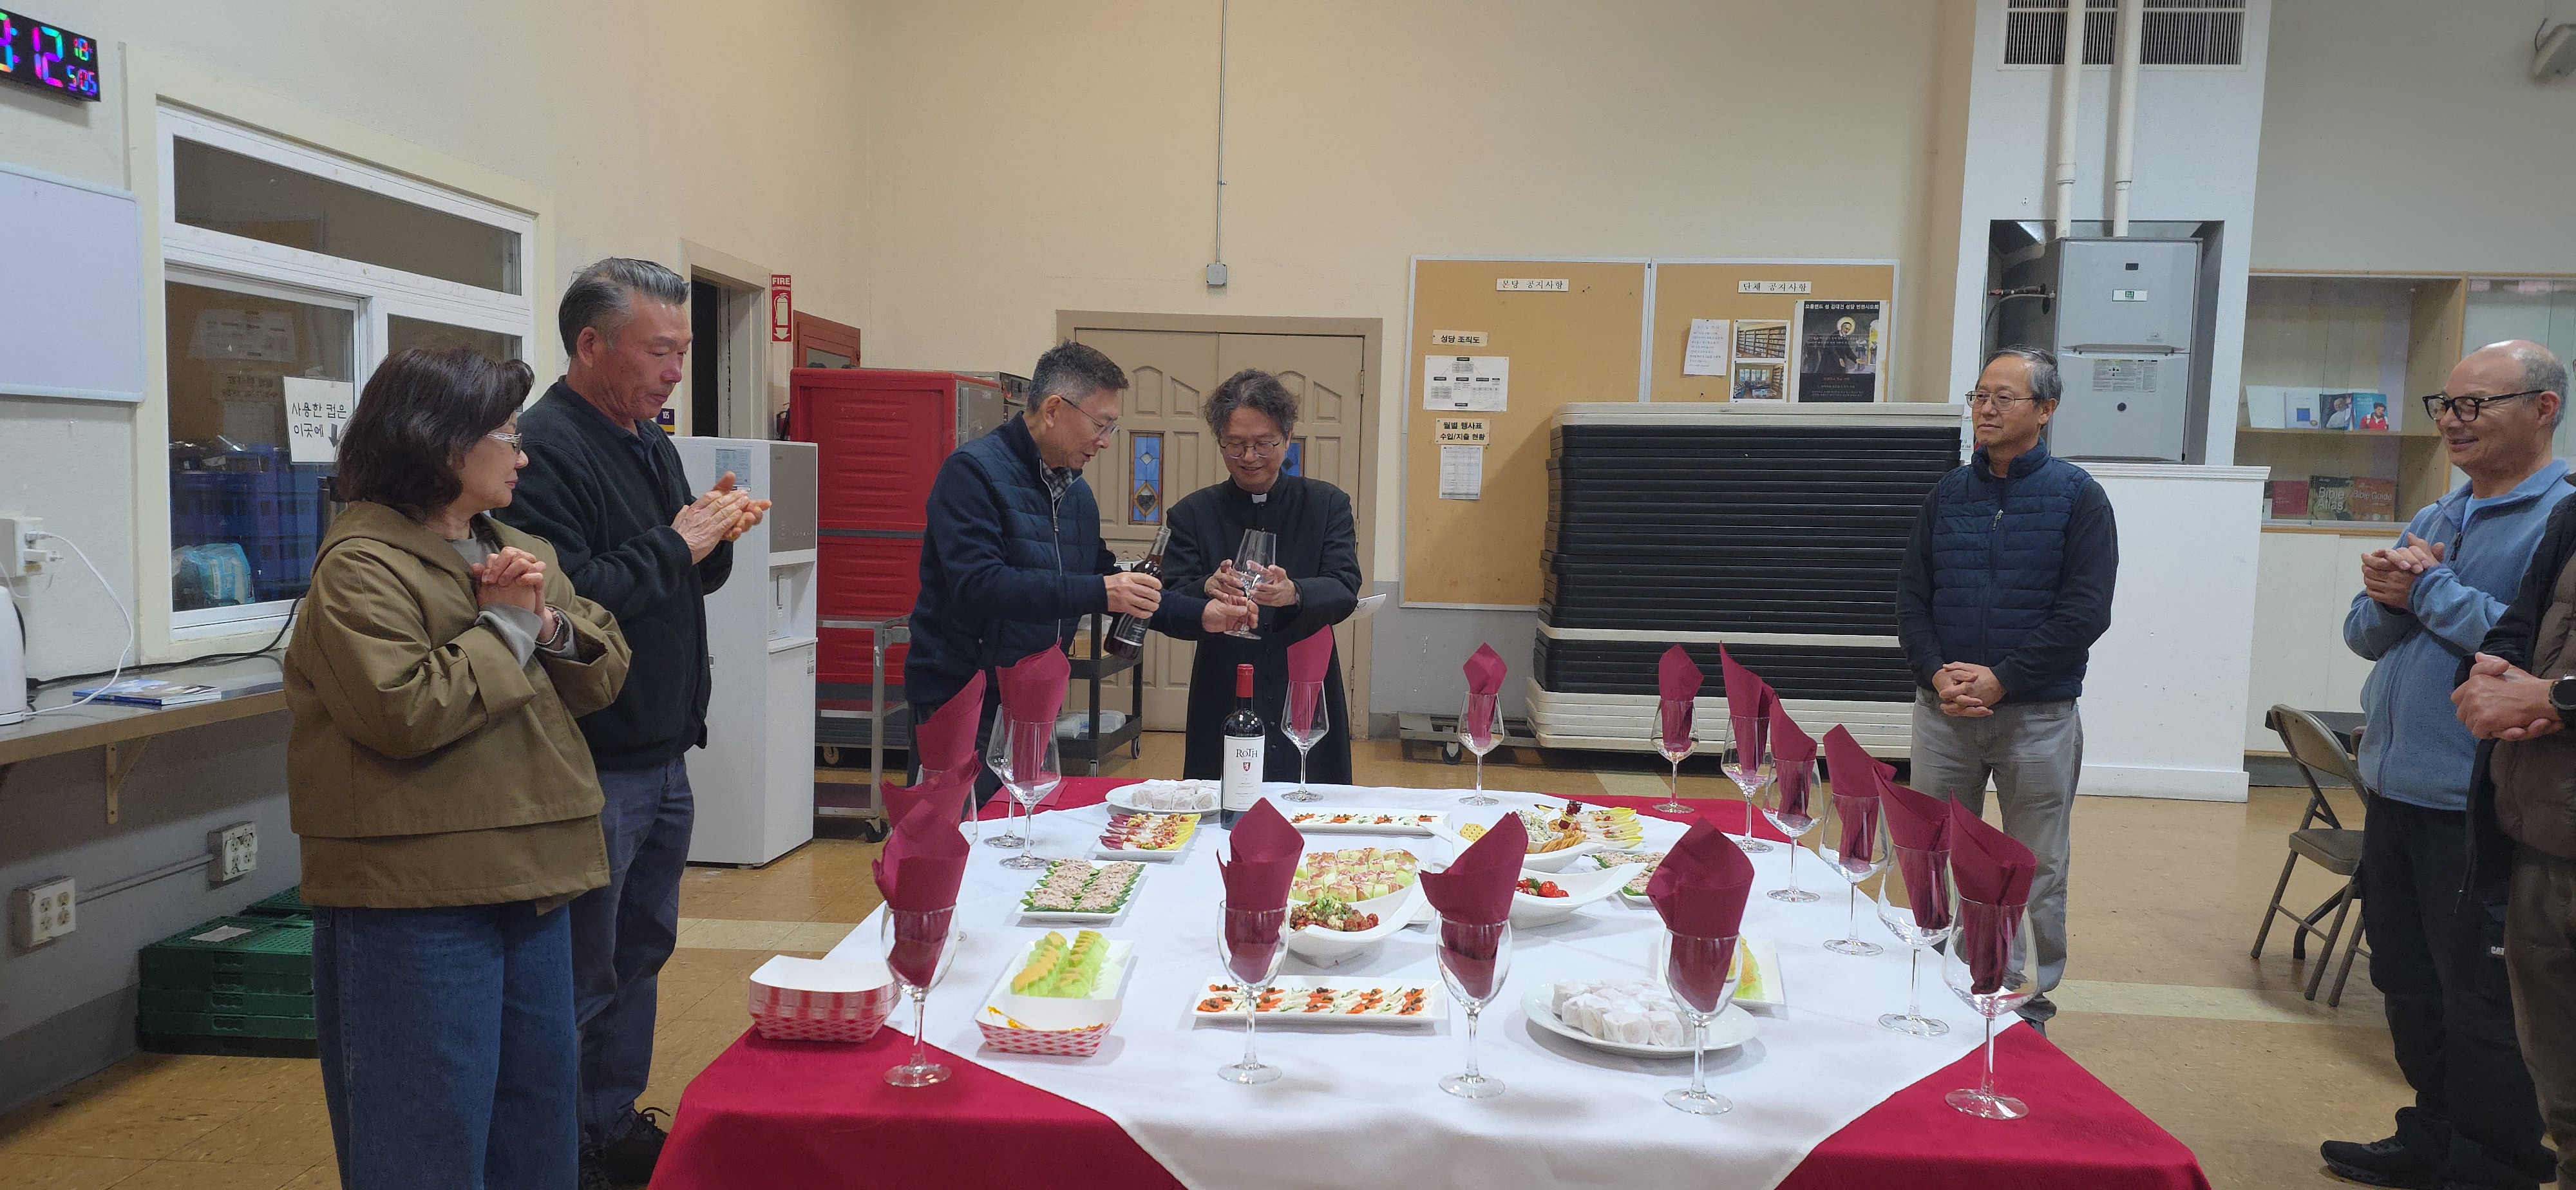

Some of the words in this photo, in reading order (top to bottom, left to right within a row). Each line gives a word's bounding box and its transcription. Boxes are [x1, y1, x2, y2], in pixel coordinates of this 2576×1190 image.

[772, 277, 791, 285] FIRE
[1502, 280, 1519, 288] 본당
[1526, 280, 1564, 289] 공지사항
[1743, 282, 1761, 291] 단체
[1768, 282, 1807, 292] 공지사항
[292, 402, 322, 417] 사용한
[326, 404, 346, 419] 컵은
[294, 423, 324, 438] 이곳에
[2318, 486, 2345, 500] Bible
[2354, 490, 2370, 499] Bible
[2371, 491, 2393, 501] Guide
[2318, 498, 2344, 511] Atlas
[2491, 946, 2505, 956] CAT
